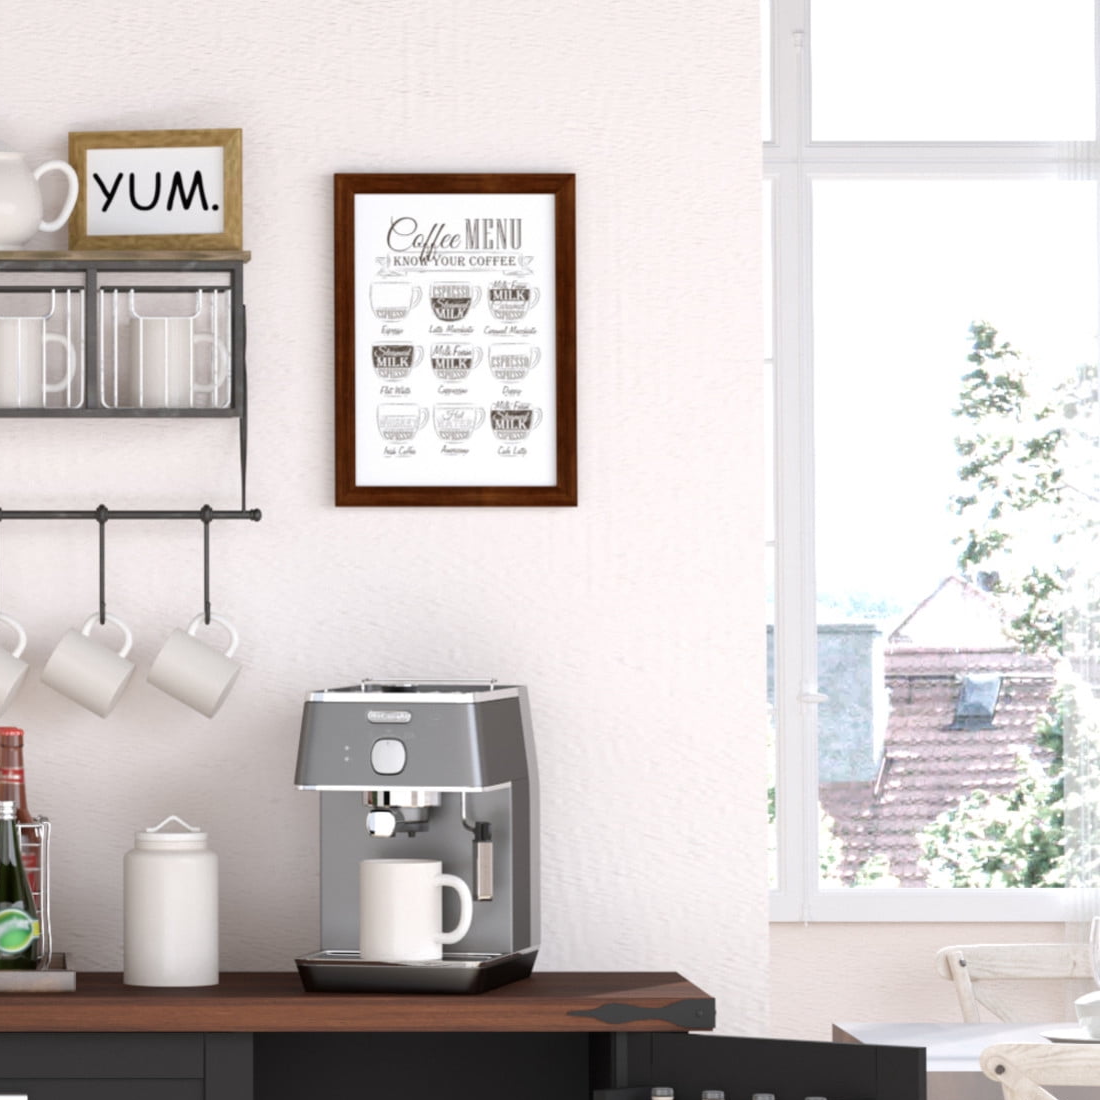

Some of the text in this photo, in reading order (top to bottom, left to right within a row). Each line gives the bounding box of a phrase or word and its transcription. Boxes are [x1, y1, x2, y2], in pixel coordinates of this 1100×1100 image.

[93, 170, 219, 212] YUM.
[387, 216, 522, 263] Coffee MENU
[394, 256, 516, 266] KNOW YOUR COFFEE
[493, 290, 525, 300] MILK
[436, 307, 467, 319] MILK
[377, 356, 409, 368] MILK
[435, 358, 468, 369] MILK
[494, 419, 526, 431] MILK
